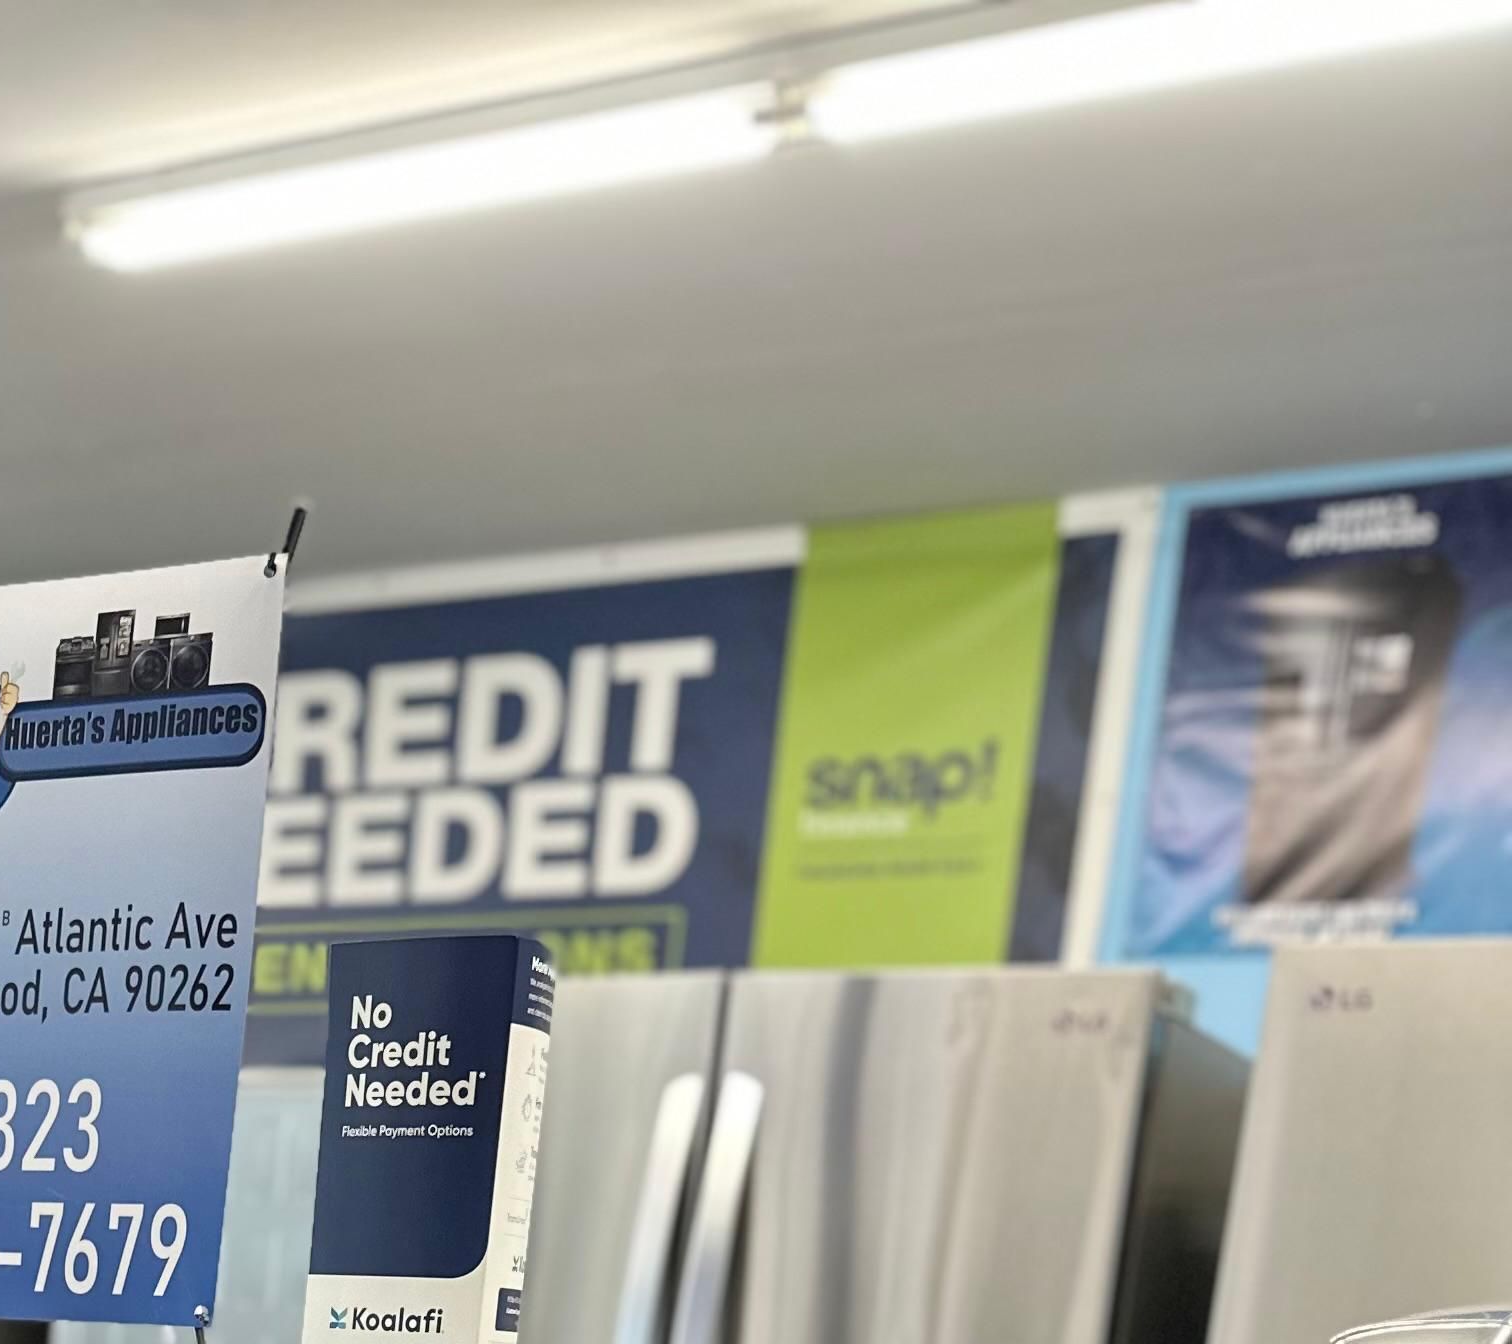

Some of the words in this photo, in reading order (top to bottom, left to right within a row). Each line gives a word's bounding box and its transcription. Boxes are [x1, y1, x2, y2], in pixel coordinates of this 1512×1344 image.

[5, 714, 104, 750] Huerta's
[110, 703, 258, 744] Appliances
[268, 634, 715, 791] REDIT
[256, 774, 699, 907] EEDED
[2, 910, 10, 926] B
[15, 904, 154, 955] Atlantic
[165, 901, 238, 951] Ave
[63, 966, 110, 1014] CA
[125, 963, 234, 1013] 90262
[351, 994, 392, 1030] No
[347, 1030, 451, 1069] Credit
[342, 1124, 377, 1138] Flexible
[379, 1125, 425, 1140] Payment
[427, 1124, 474, 1139] Options
[351, 1306, 444, 1334] Koalafi
